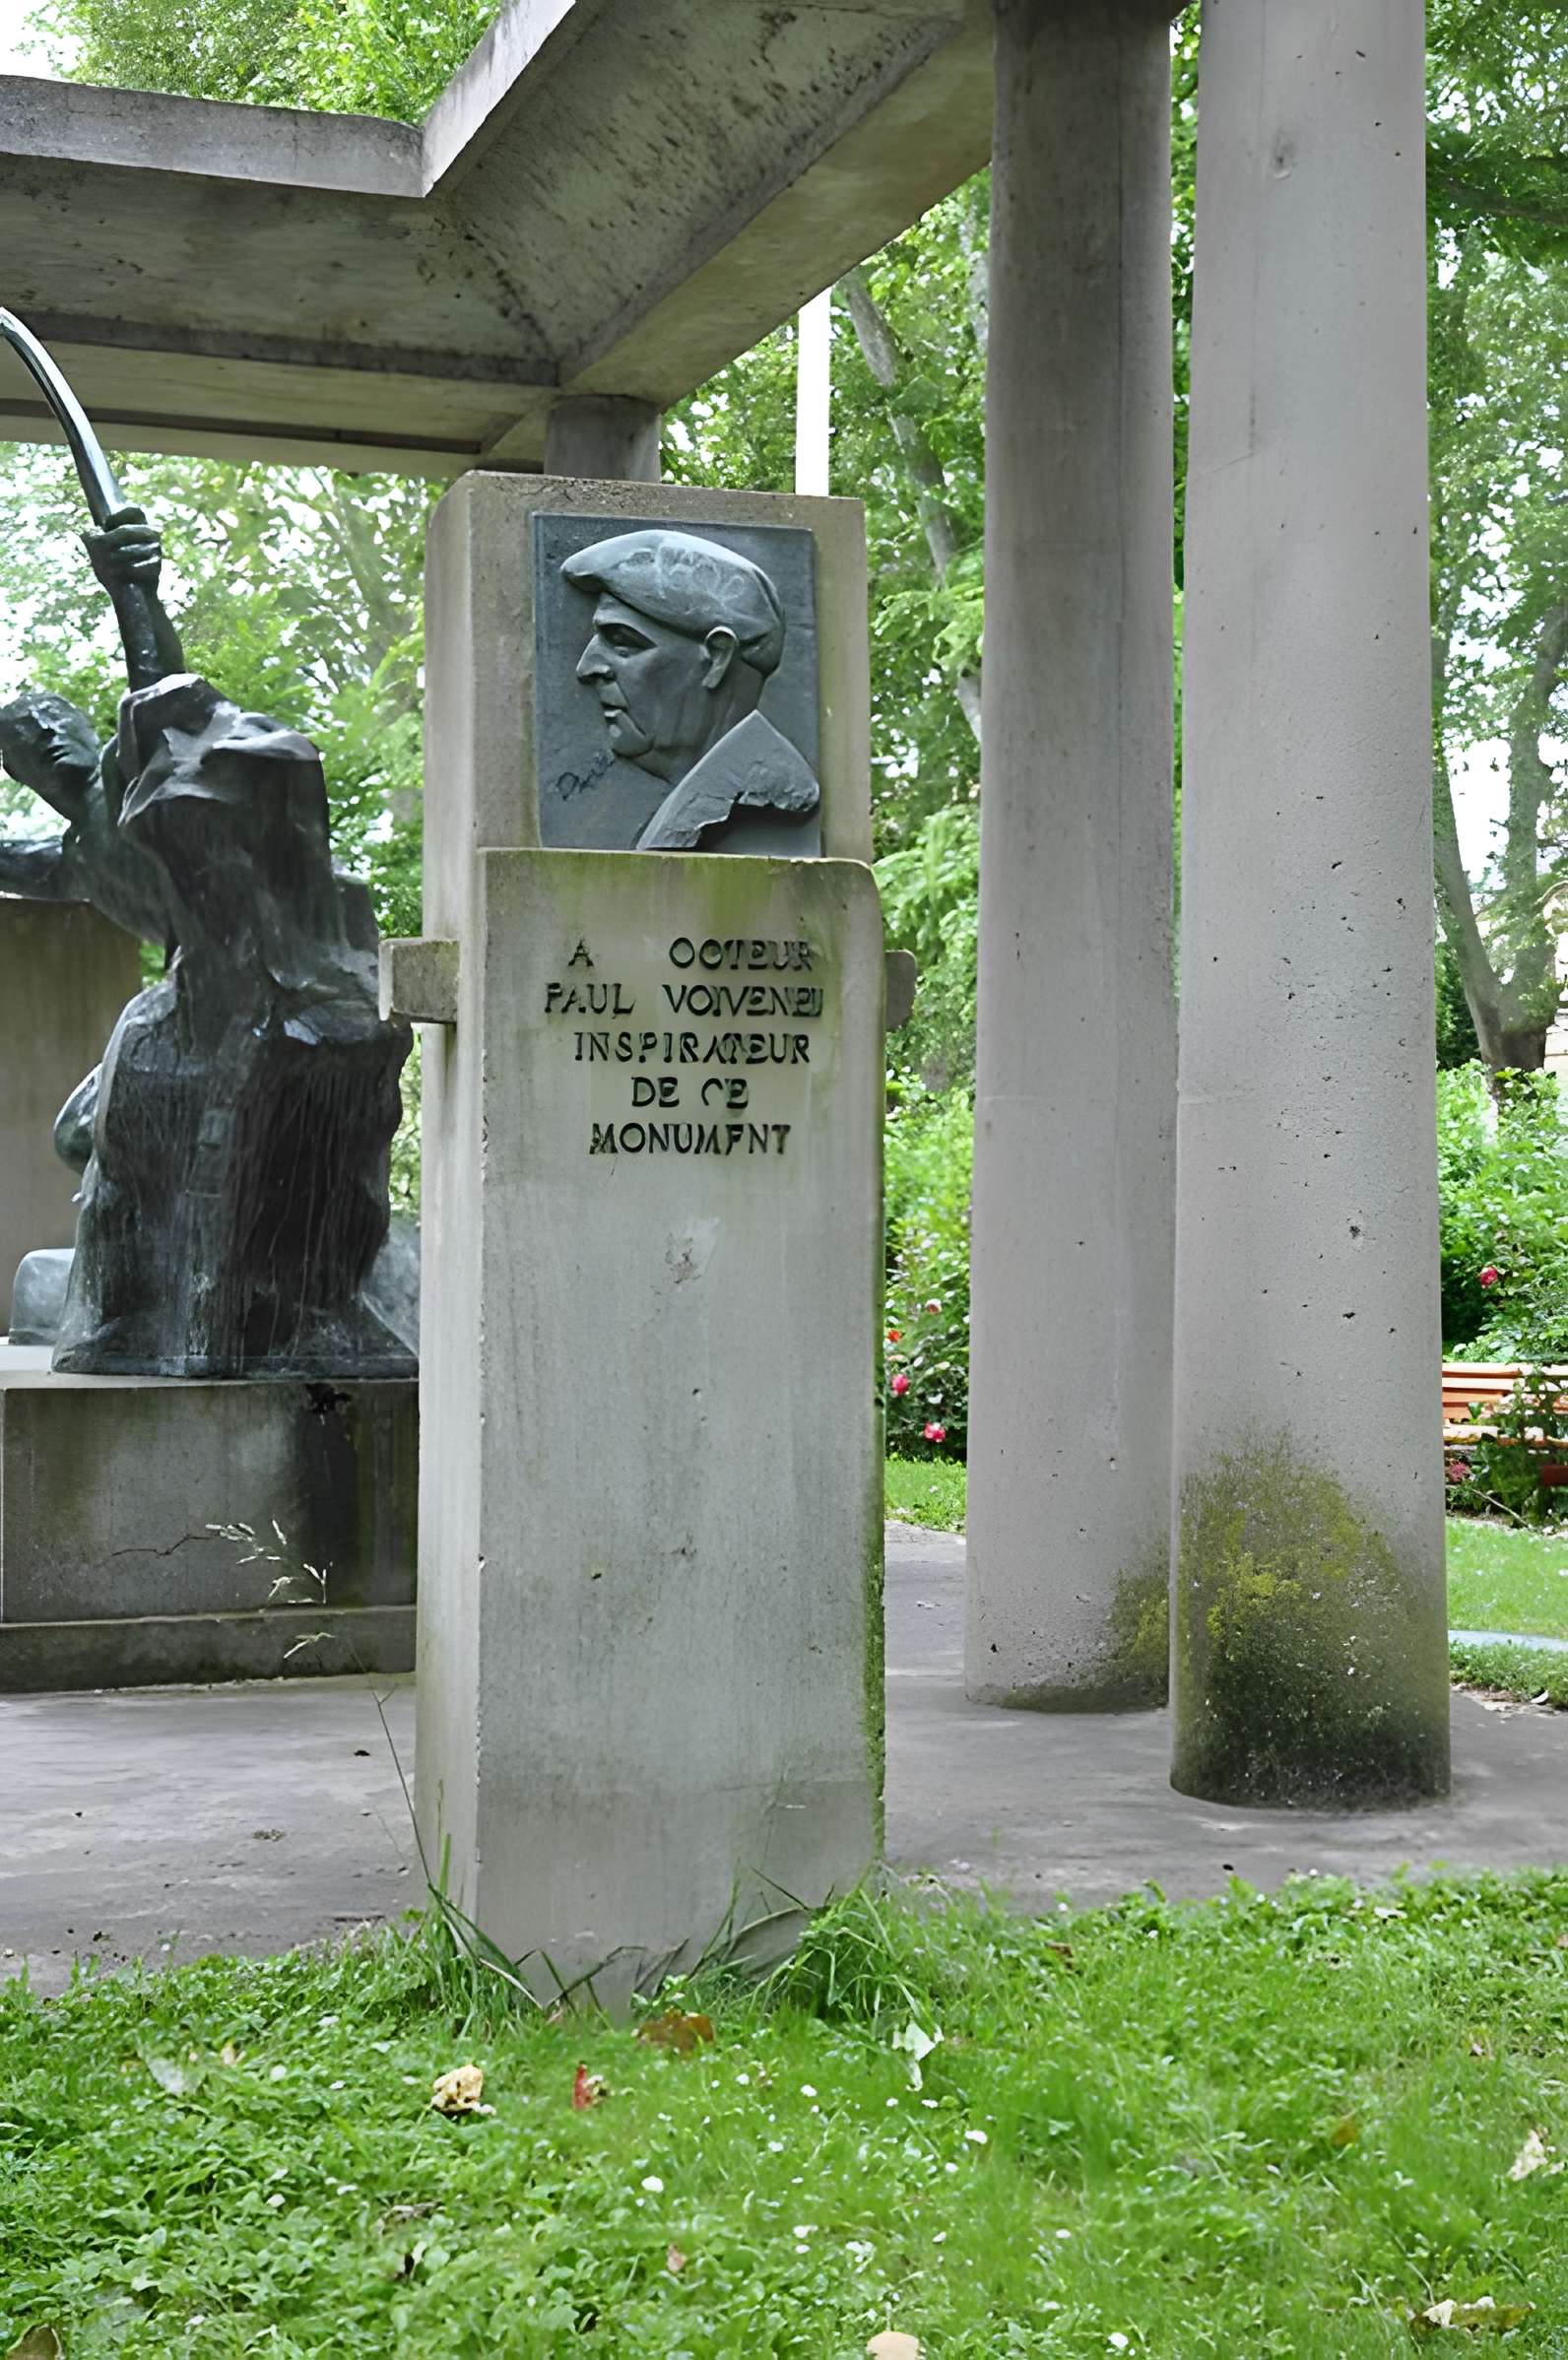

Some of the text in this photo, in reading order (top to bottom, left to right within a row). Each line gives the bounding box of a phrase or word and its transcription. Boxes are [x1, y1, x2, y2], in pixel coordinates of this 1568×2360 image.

[544, 982, 637, 1017] PAUL
[573, 1031, 810, 1065] INSPIRATEUR
[631, 1076, 750, 1109] DE CE
